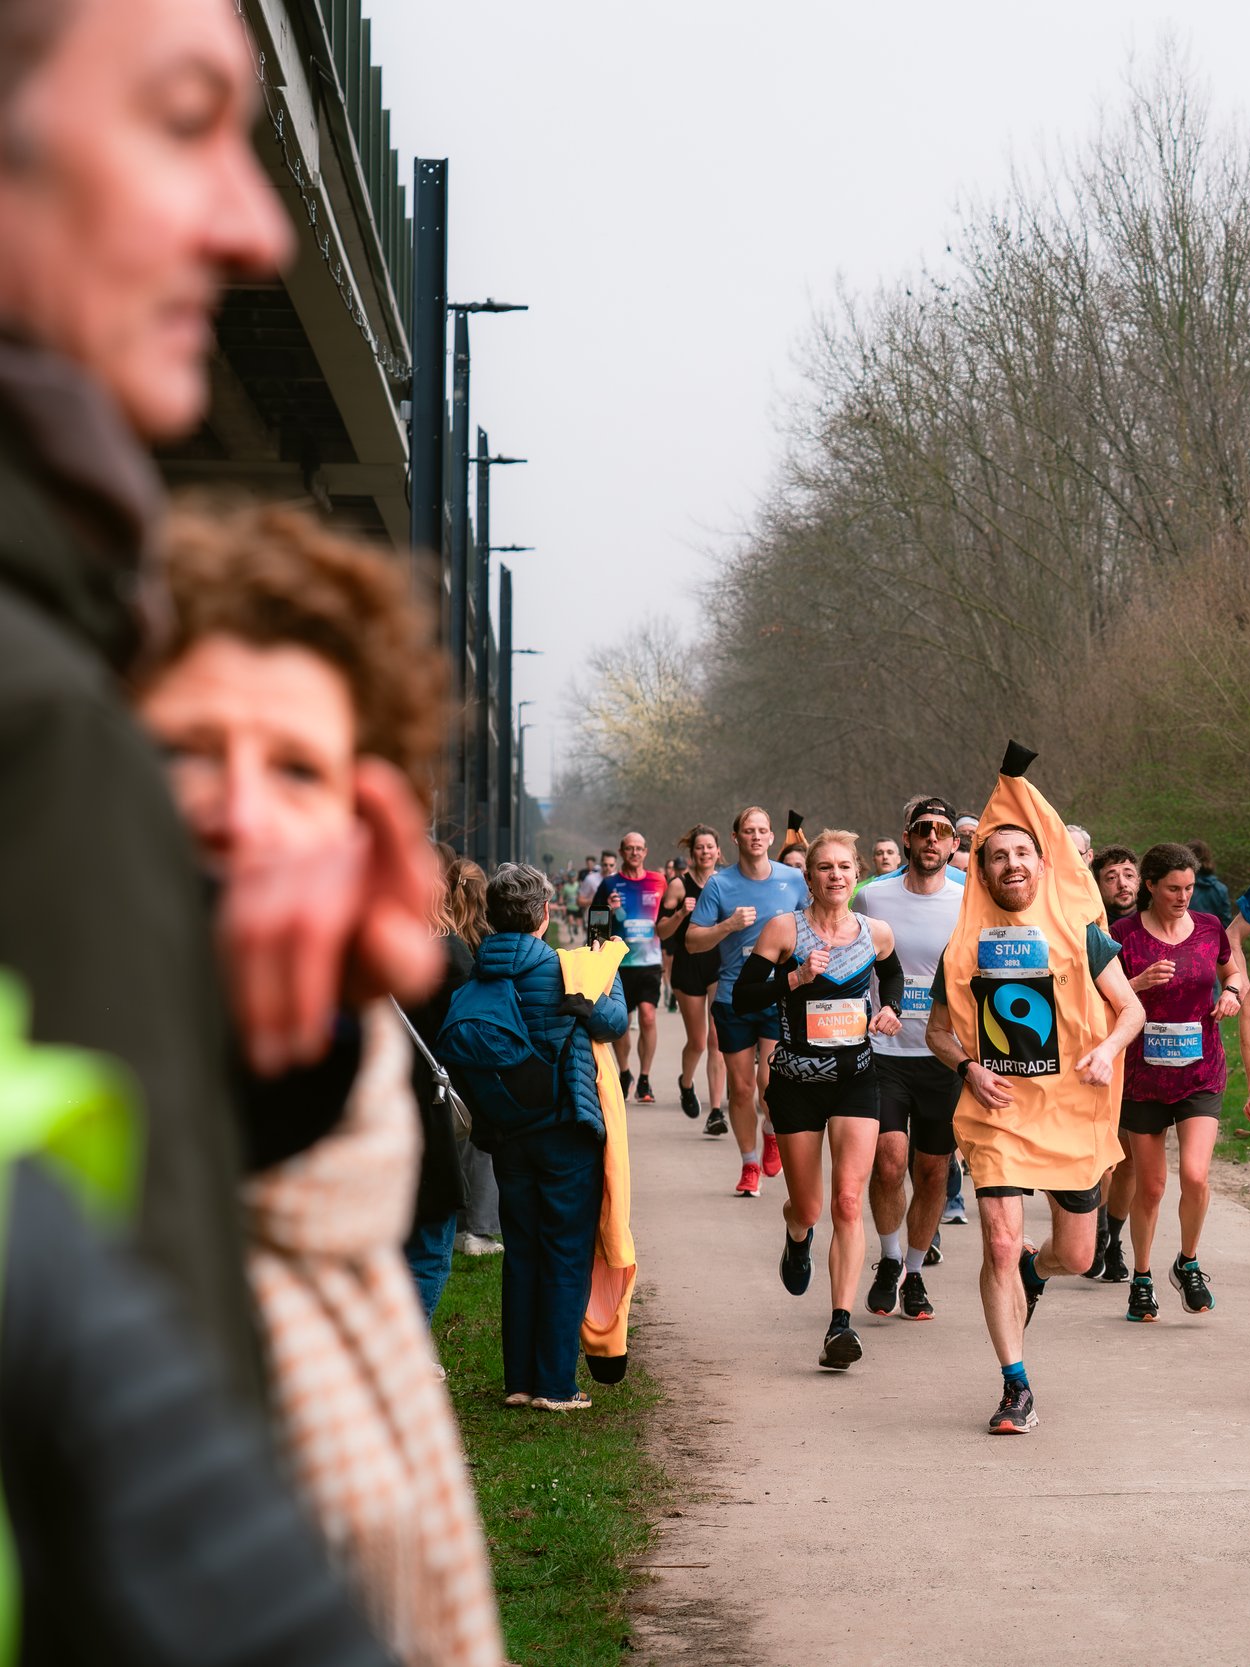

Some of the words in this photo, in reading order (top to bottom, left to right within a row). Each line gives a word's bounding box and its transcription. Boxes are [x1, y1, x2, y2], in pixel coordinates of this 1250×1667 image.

[995, 944, 1031, 955] STIJN
[817, 1015, 860, 1027] ANNICK
[1148, 1037, 1198, 1046] KATELIJNE
[983, 1059, 1057, 1074] FAIRTRADE
